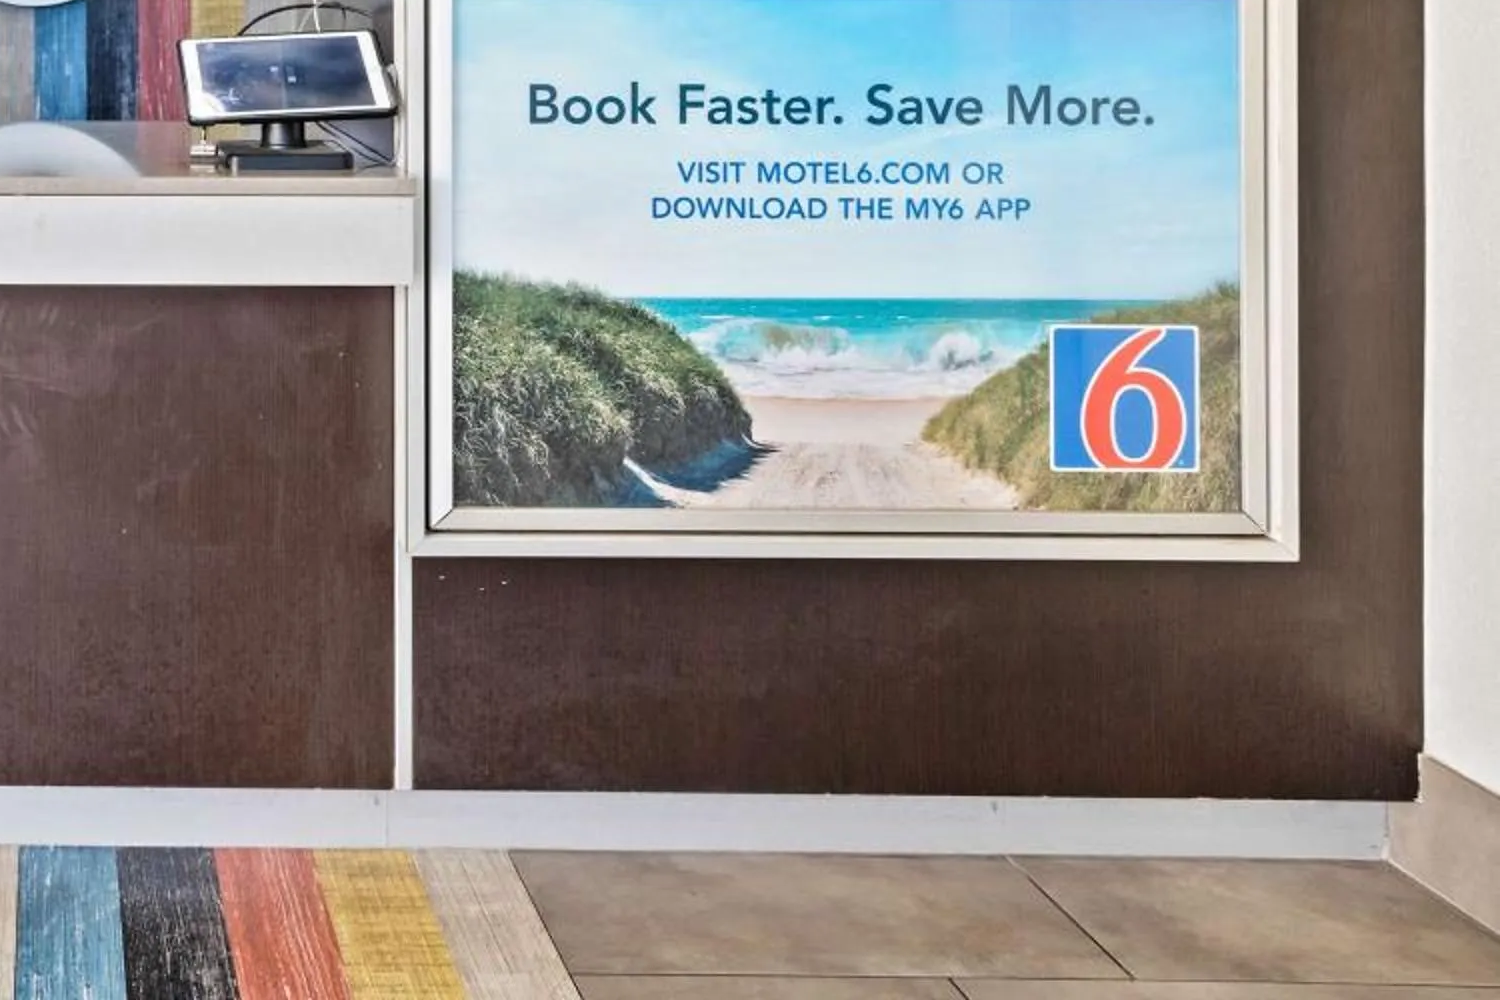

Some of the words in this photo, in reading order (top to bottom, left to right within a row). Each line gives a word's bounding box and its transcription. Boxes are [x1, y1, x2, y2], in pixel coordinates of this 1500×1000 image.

[529, 81, 657, 126] Book
[678, 83, 845, 126] Faster.
[866, 83, 983, 126] Save
[1007, 84, 1155, 126] More.
[677, 161, 747, 184] VISIT
[757, 161, 950, 185] MOTEL6.COM
[962, 162, 1004, 185] OR
[651, 197, 828, 220] DOWNLOAD
[840, 197, 893, 220] THE
[905, 198, 964, 220] MY6
[975, 198, 1031, 220] APP
[1080, 327, 1187, 473] 6
